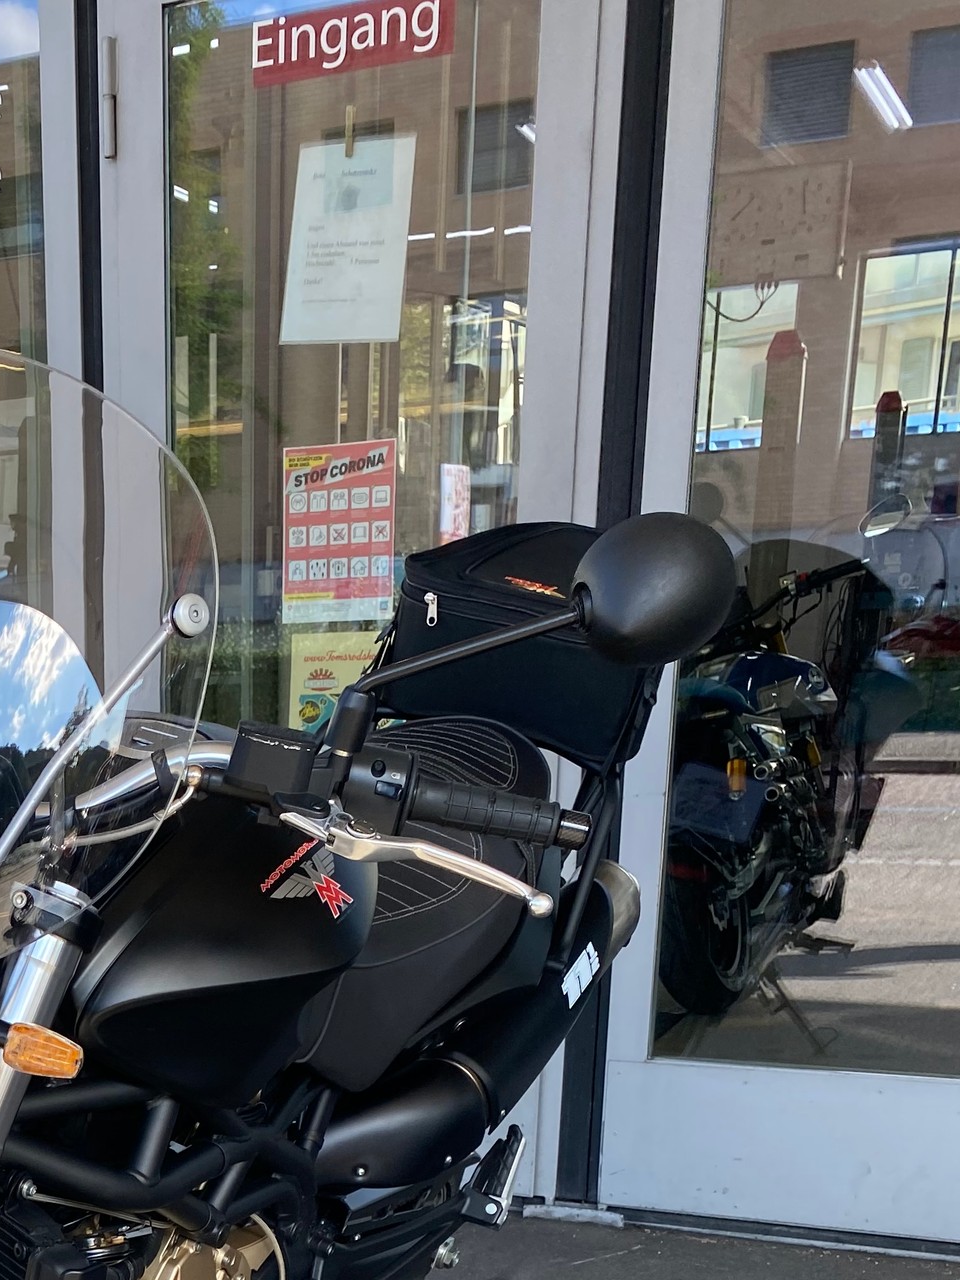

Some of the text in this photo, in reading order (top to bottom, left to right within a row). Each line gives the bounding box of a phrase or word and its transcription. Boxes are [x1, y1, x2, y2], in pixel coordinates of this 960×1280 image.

[252, 0, 440, 69] Eingang
[294, 452, 386, 488] STOP CORONA
